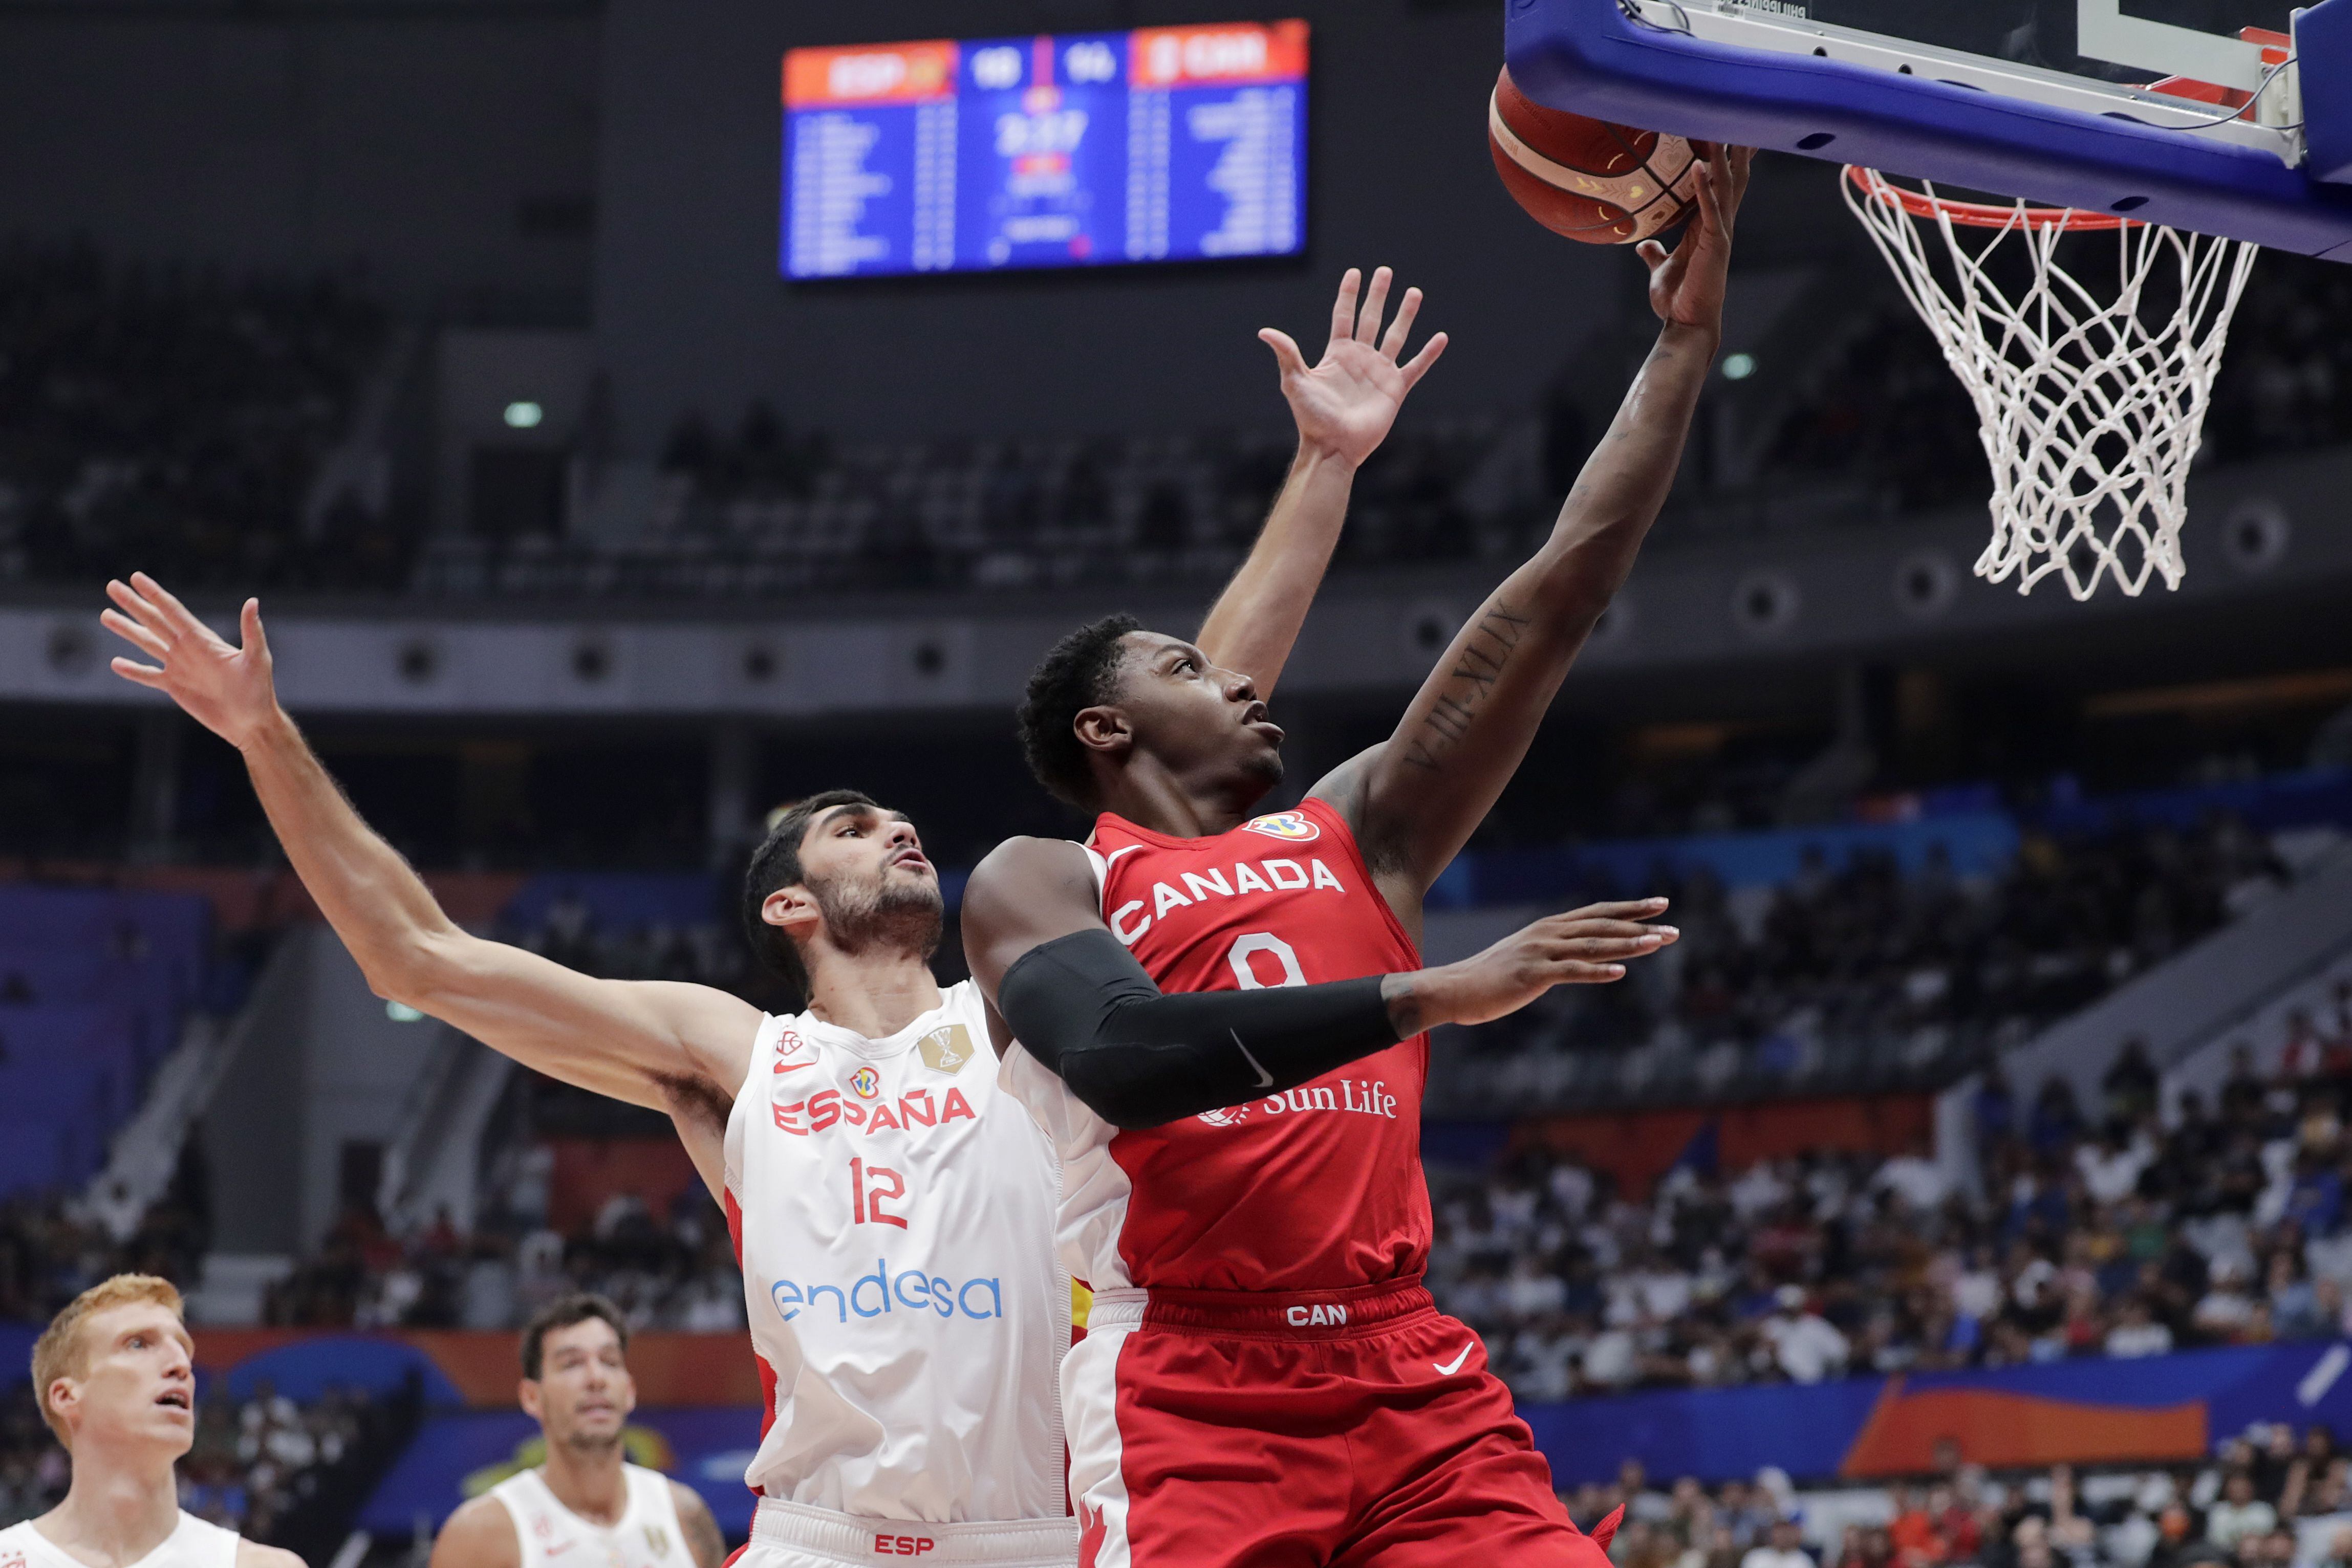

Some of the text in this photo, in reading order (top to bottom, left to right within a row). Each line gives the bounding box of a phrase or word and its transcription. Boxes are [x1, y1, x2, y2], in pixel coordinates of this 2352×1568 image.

[1110, 858, 1345, 946] CANADA
[771, 1086, 976, 1136] ESPAÑA
[1263, 1079, 1397, 1119] Sun Life
[849, 1157, 908, 1231] 12
[771, 1258, 1002, 1323] endesa
[1286, 1304, 1347, 1327] CAN
[874, 1533, 935, 1556] ESP
